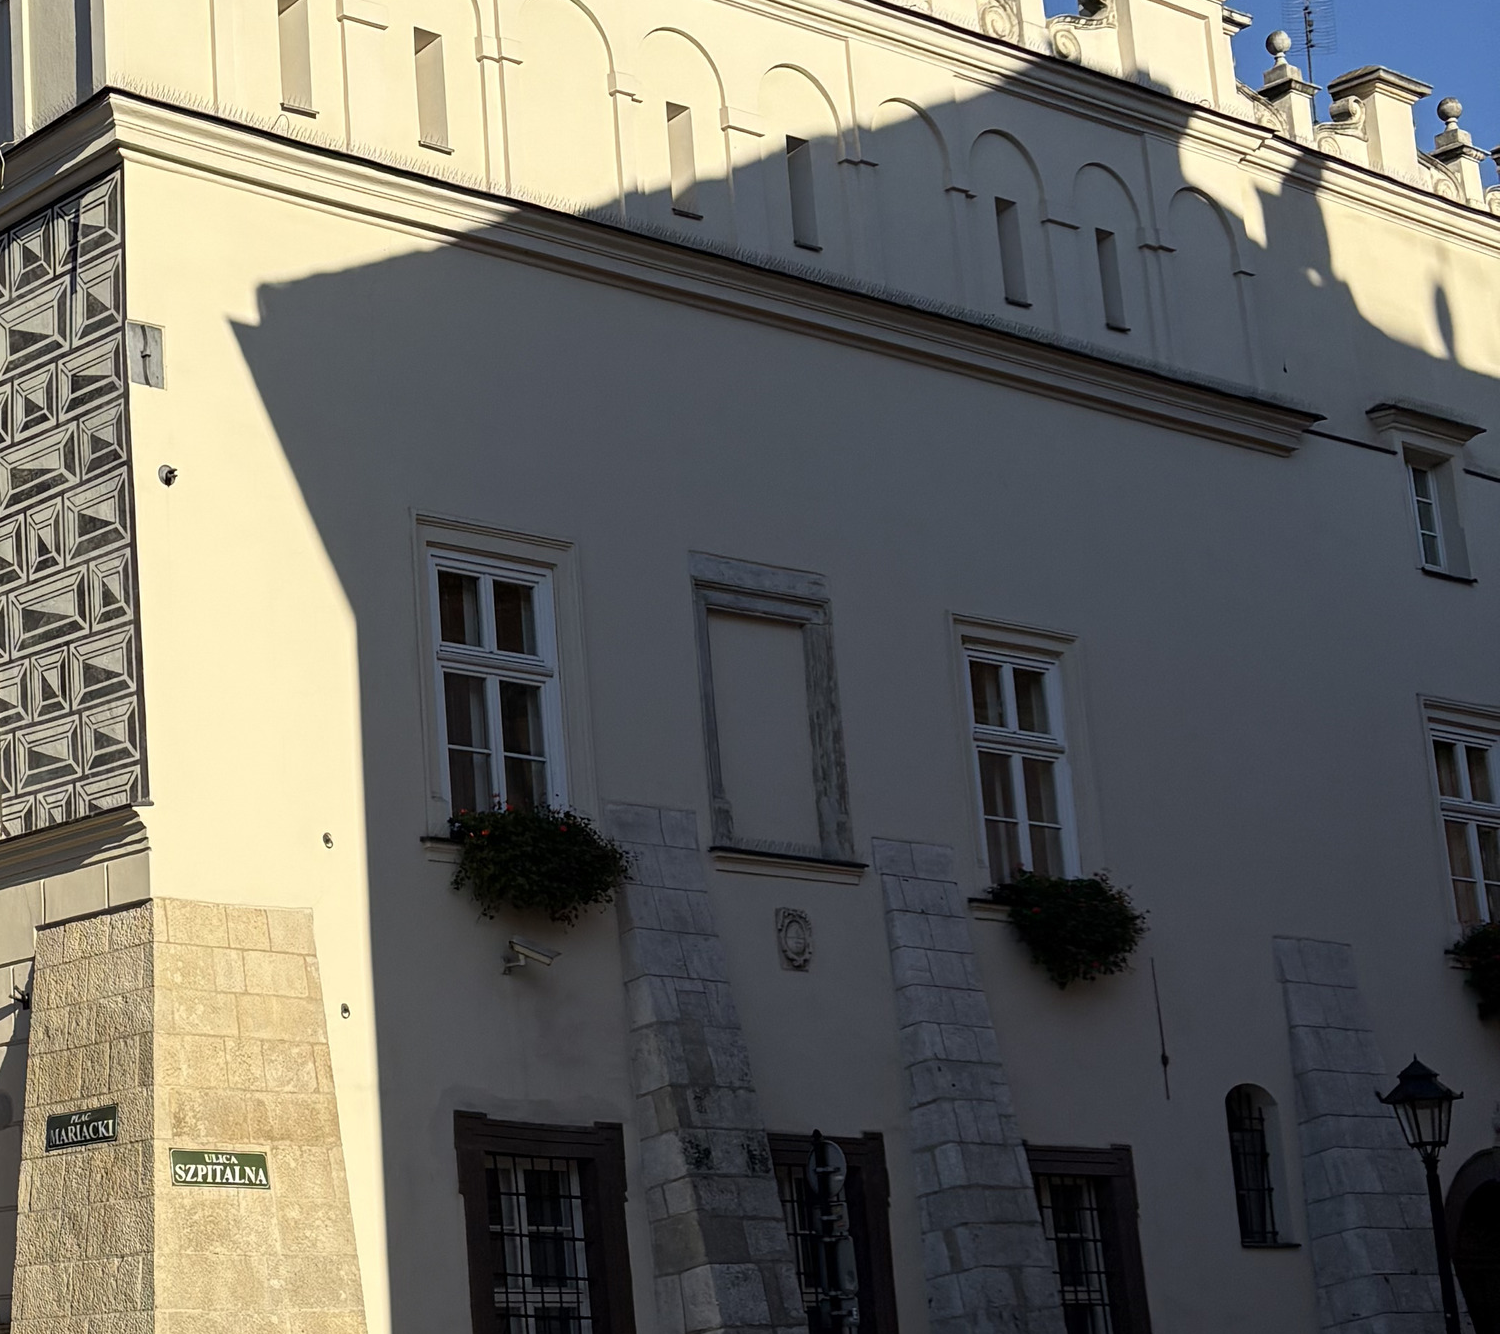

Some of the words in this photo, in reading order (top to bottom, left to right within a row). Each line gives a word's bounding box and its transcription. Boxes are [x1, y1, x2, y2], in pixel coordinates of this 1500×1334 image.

[70, 1112, 91, 1124] PLAC
[50, 1119, 114, 1146] MARIACKI
[204, 1153, 238, 1165] ULICA
[174, 1164, 268, 1185] SZPITALNA
